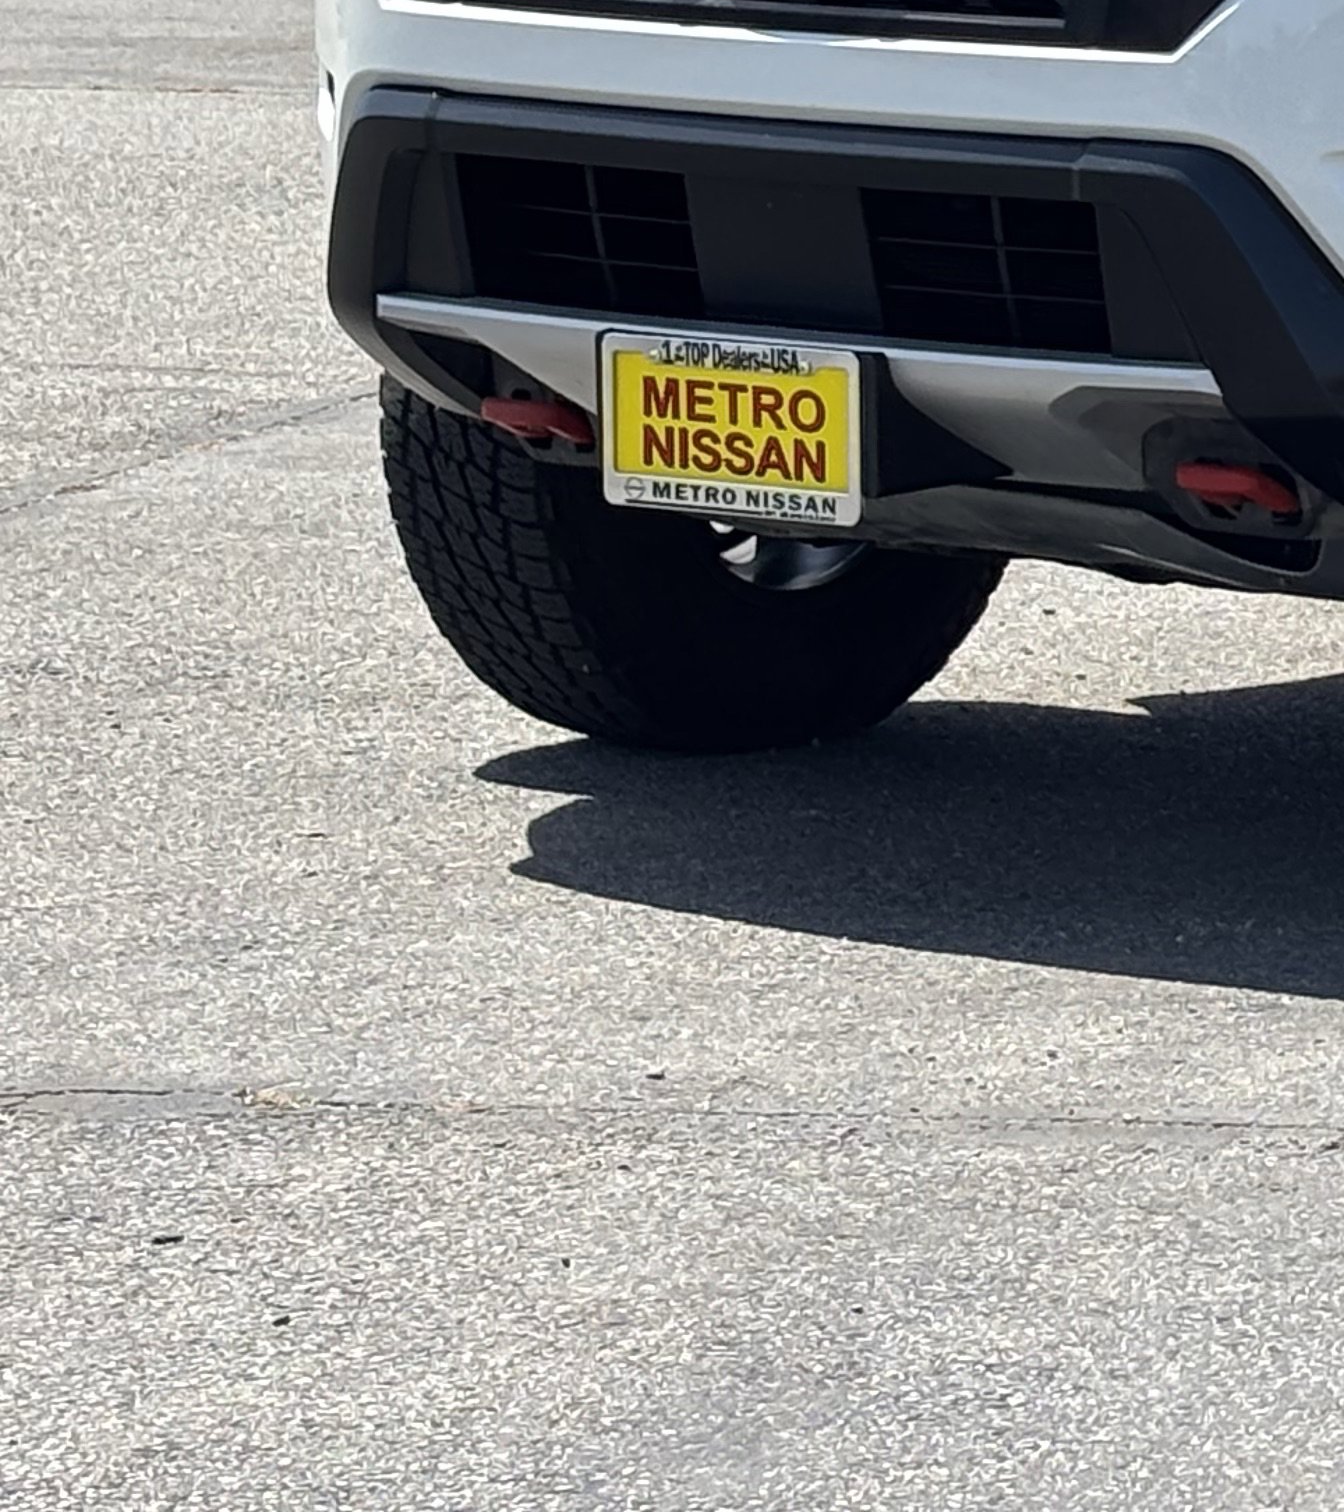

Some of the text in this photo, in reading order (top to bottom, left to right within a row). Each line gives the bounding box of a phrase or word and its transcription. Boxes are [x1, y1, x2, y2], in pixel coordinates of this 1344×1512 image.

[642, 375, 827, 434] METRO
[642, 423, 827, 484] NISSAN
[652, 481, 838, 516] METRO NISSAN
